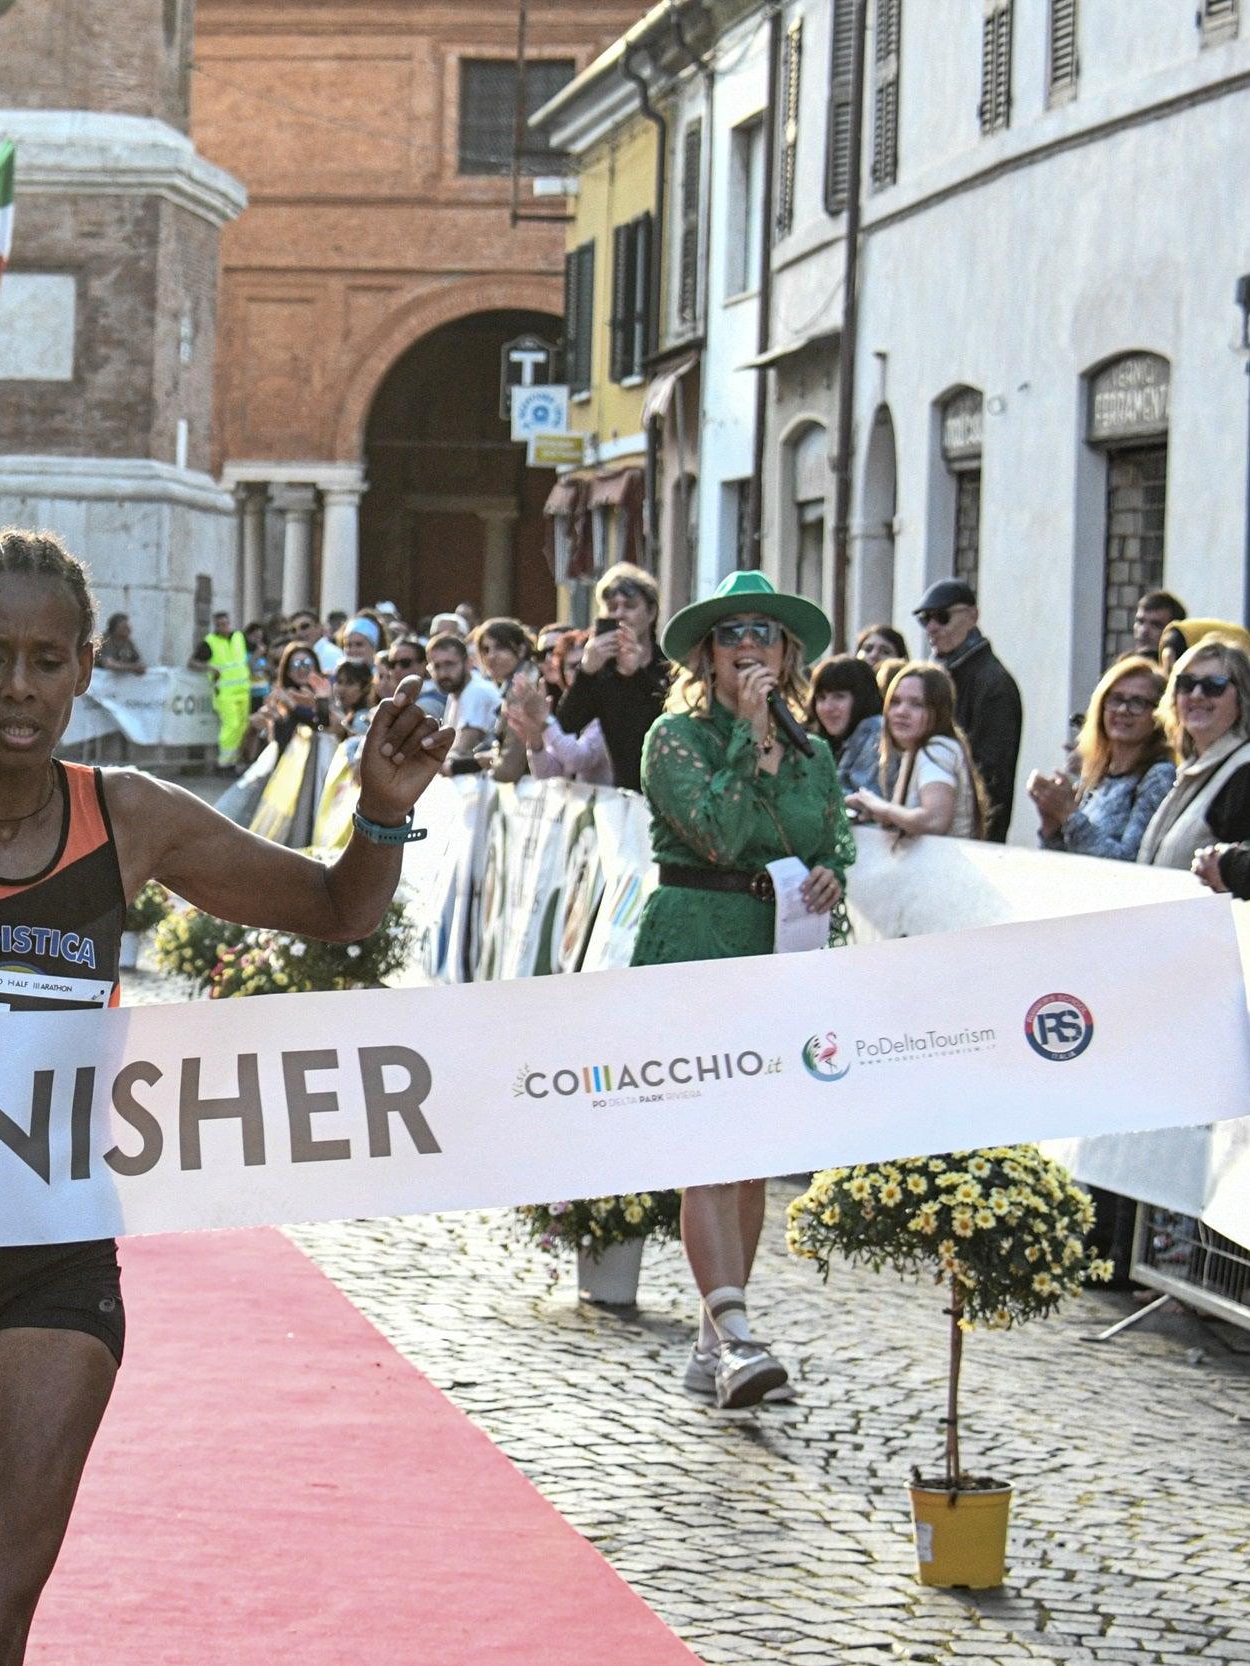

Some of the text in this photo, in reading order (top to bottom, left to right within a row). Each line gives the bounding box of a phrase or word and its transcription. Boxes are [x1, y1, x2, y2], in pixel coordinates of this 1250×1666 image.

[7, 979, 29, 988] HALF
[1037, 1009, 1082, 1045] RS
[855, 1028, 996, 1057] PoDeltaTourism
[592, 1099, 607, 1108] PO
[639, 1093, 664, 1103] PARK
